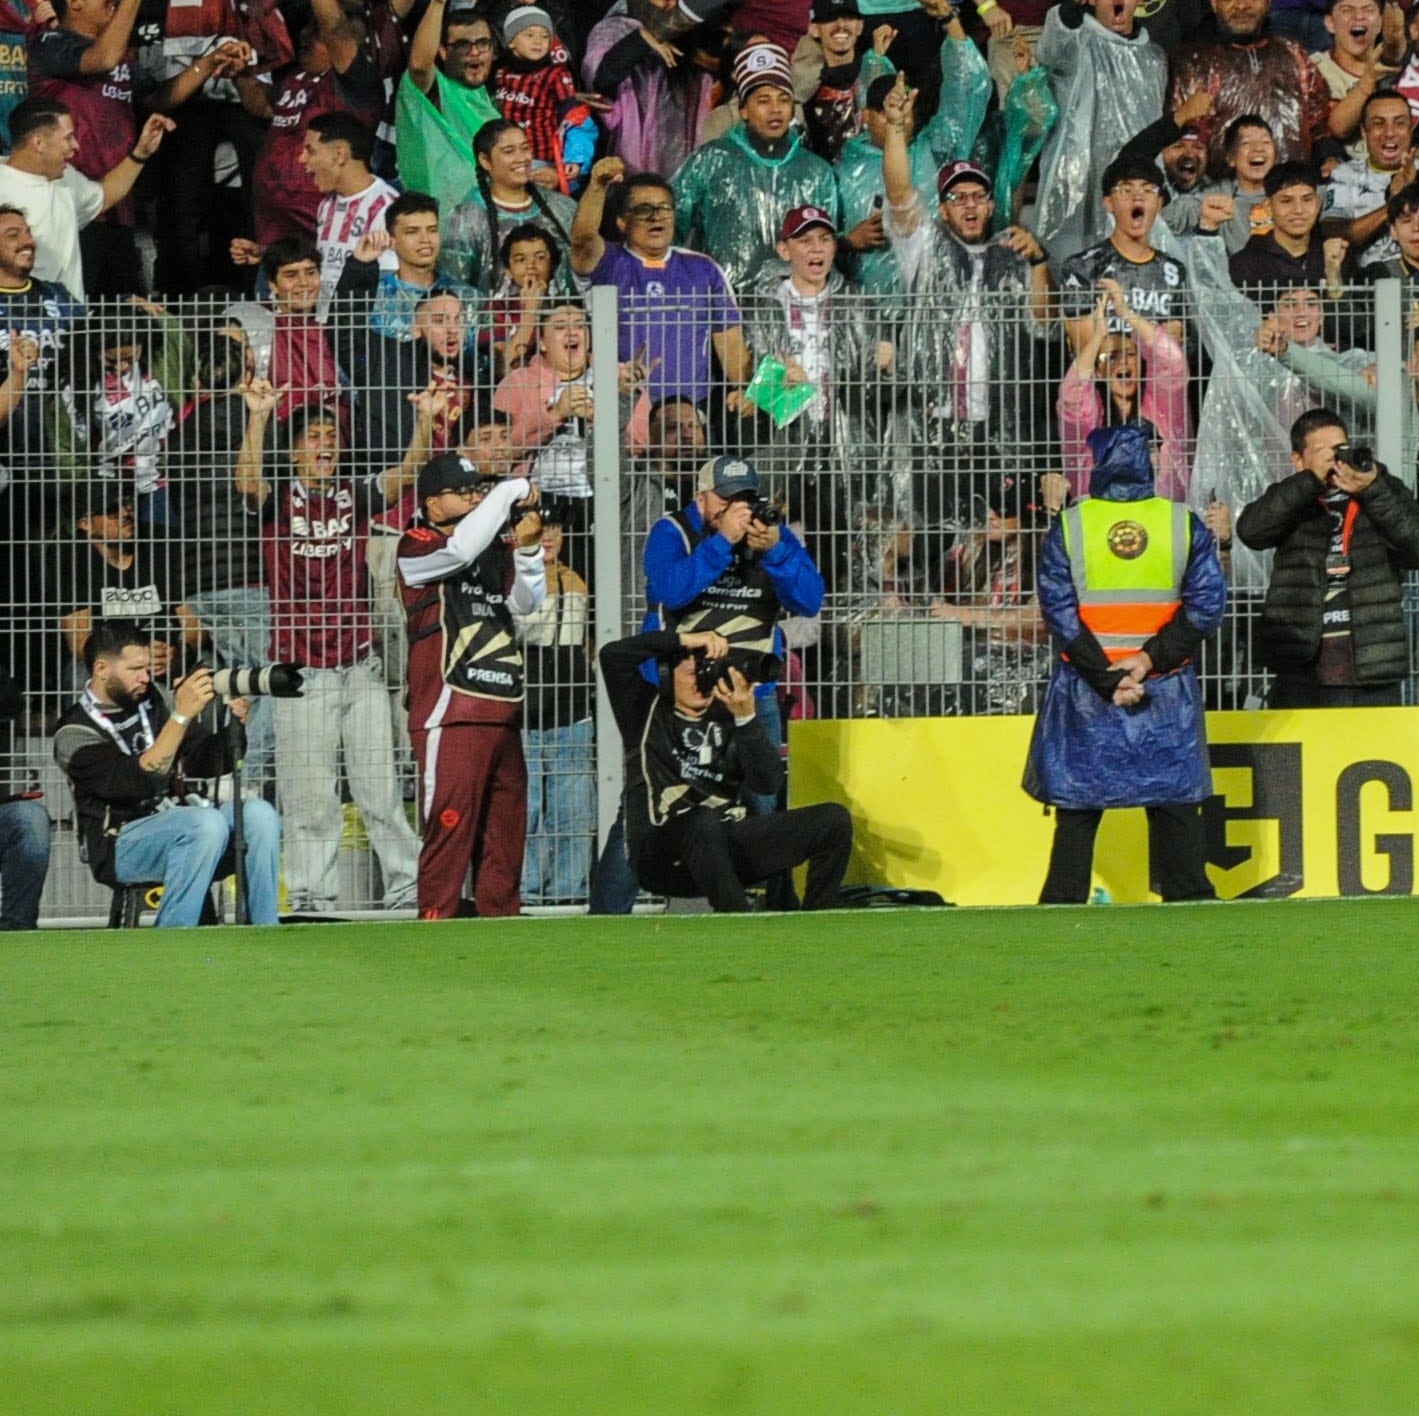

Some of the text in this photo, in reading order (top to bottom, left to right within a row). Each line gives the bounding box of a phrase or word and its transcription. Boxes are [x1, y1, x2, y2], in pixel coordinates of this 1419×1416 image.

[756, 55, 766, 67] S
[351, 216, 365, 238] S
[1163, 262, 1179, 287] S
[1131, 289, 1172, 316] BAC
[312, 514, 354, 539] BAC
[290, 540, 353, 558] LIBERTY
[467, 666, 514, 686] PRENSA
